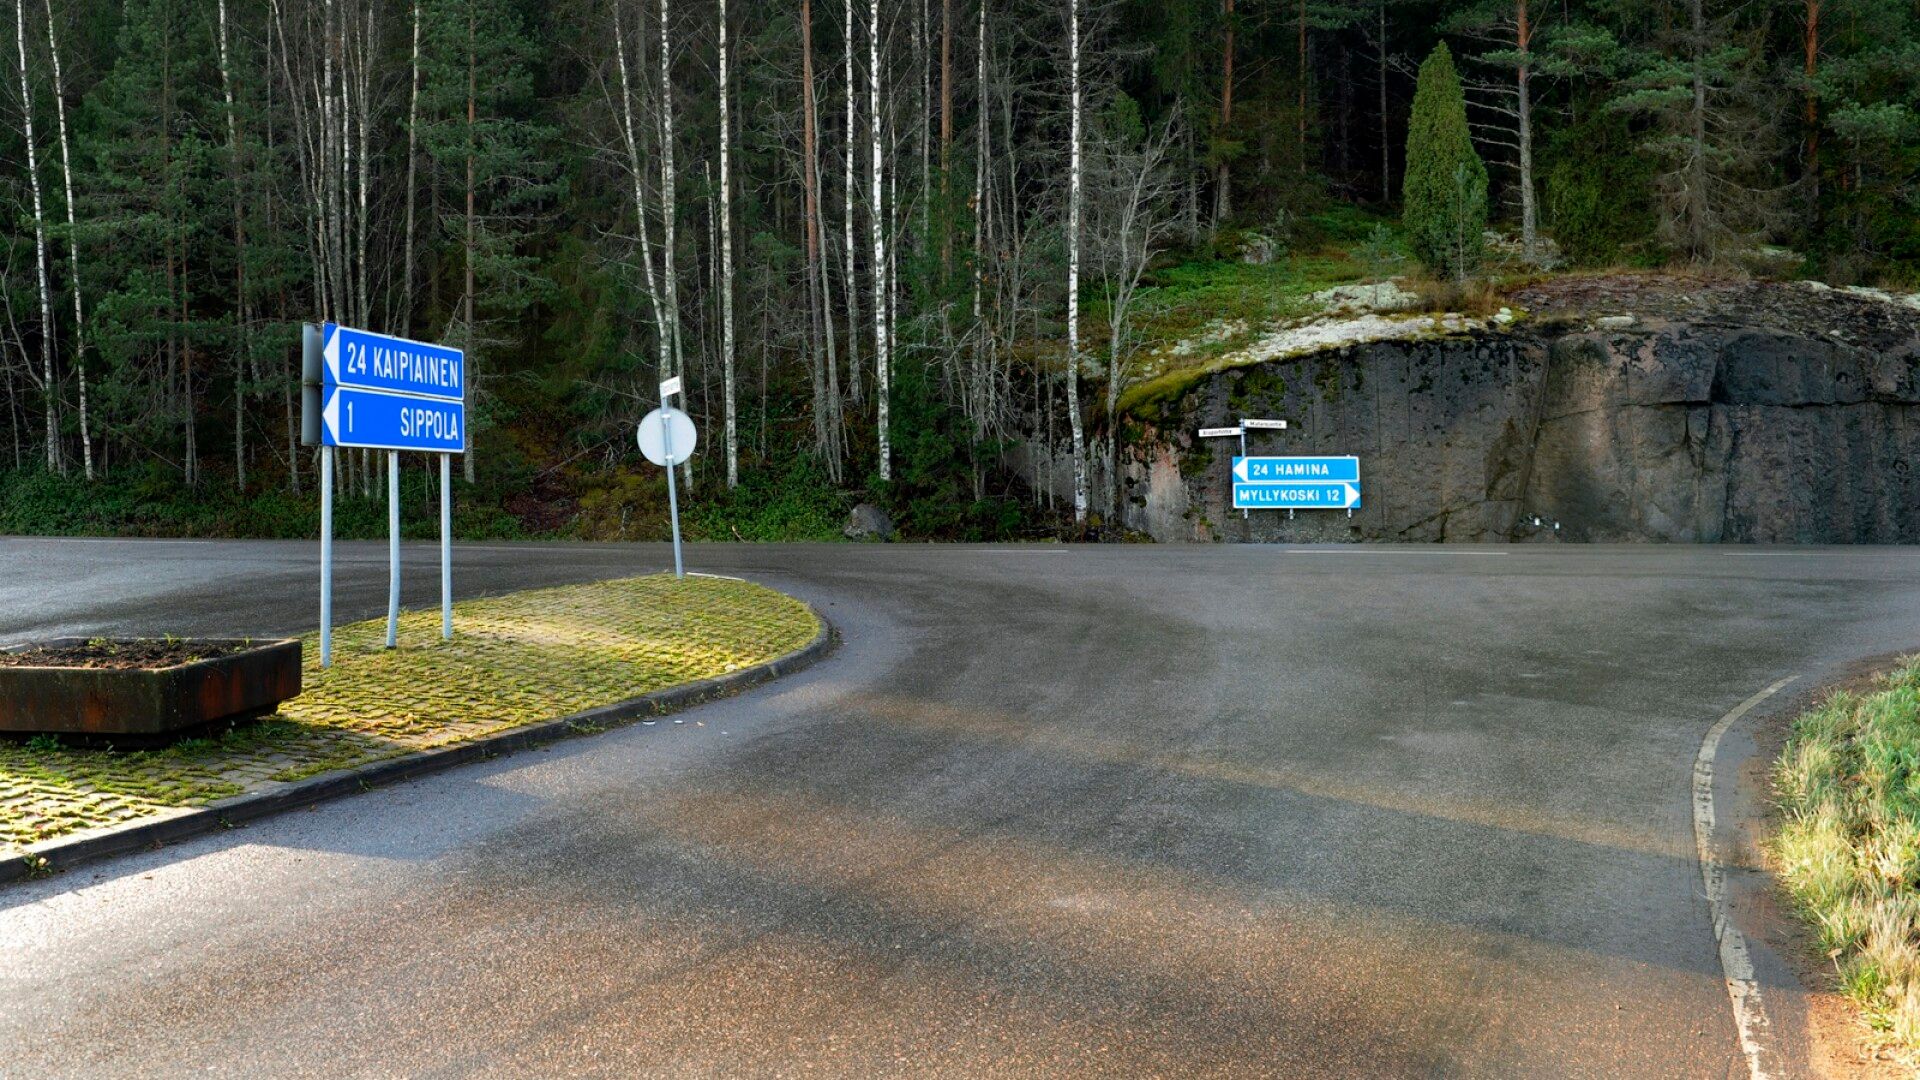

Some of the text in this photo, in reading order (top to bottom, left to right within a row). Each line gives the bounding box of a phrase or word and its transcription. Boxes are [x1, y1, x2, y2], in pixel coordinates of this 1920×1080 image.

[347, 342, 459, 389] 24 KAIPIAINEN
[347, 401, 459, 441] 1 SIPPOLA
[1253, 464, 1330, 476] 24 HAMINA
[1239, 489, 1340, 502] MYLLYKOSKI 12
